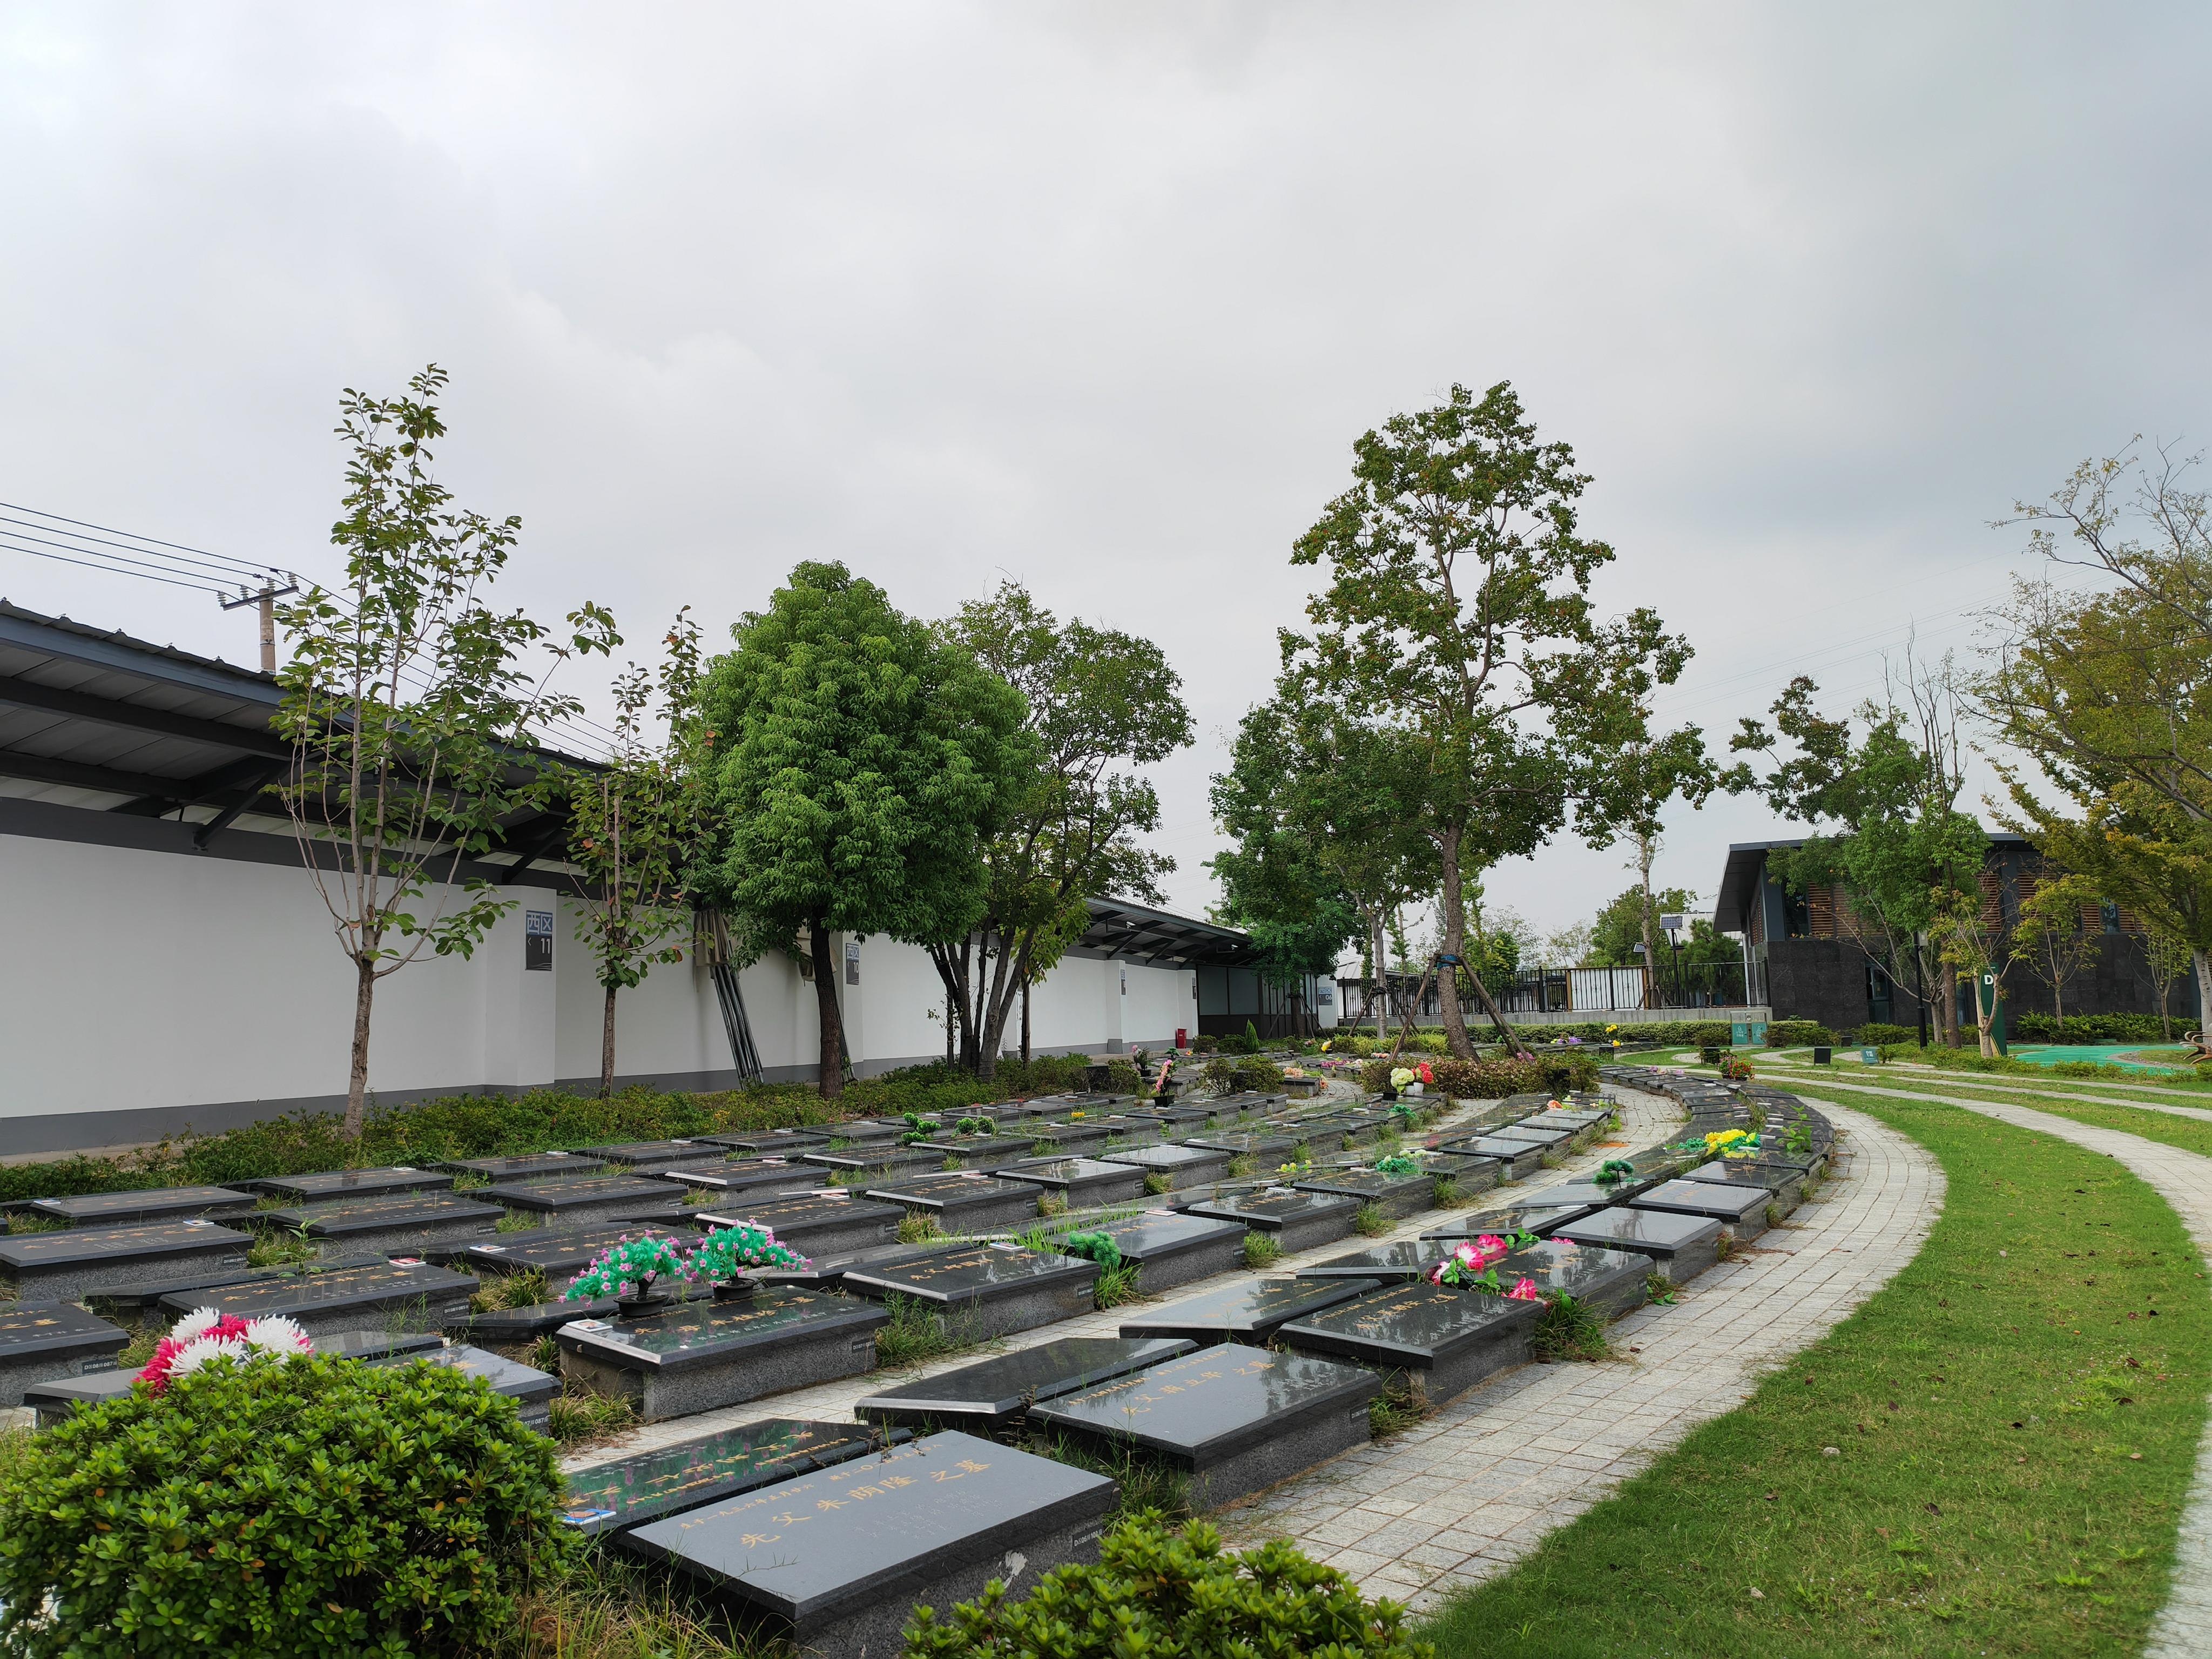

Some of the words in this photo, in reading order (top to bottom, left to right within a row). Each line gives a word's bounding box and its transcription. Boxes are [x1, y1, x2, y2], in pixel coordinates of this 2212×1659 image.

[527, 912, 552, 935] 西区
[541, 938, 550, 954] 11
[847, 944, 859, 960] 西区
[854, 962, 859, 974] 10
[1984, 975, 1994, 985] D
[740, 1459, 992, 1548] 先父朱荫隆之墓
